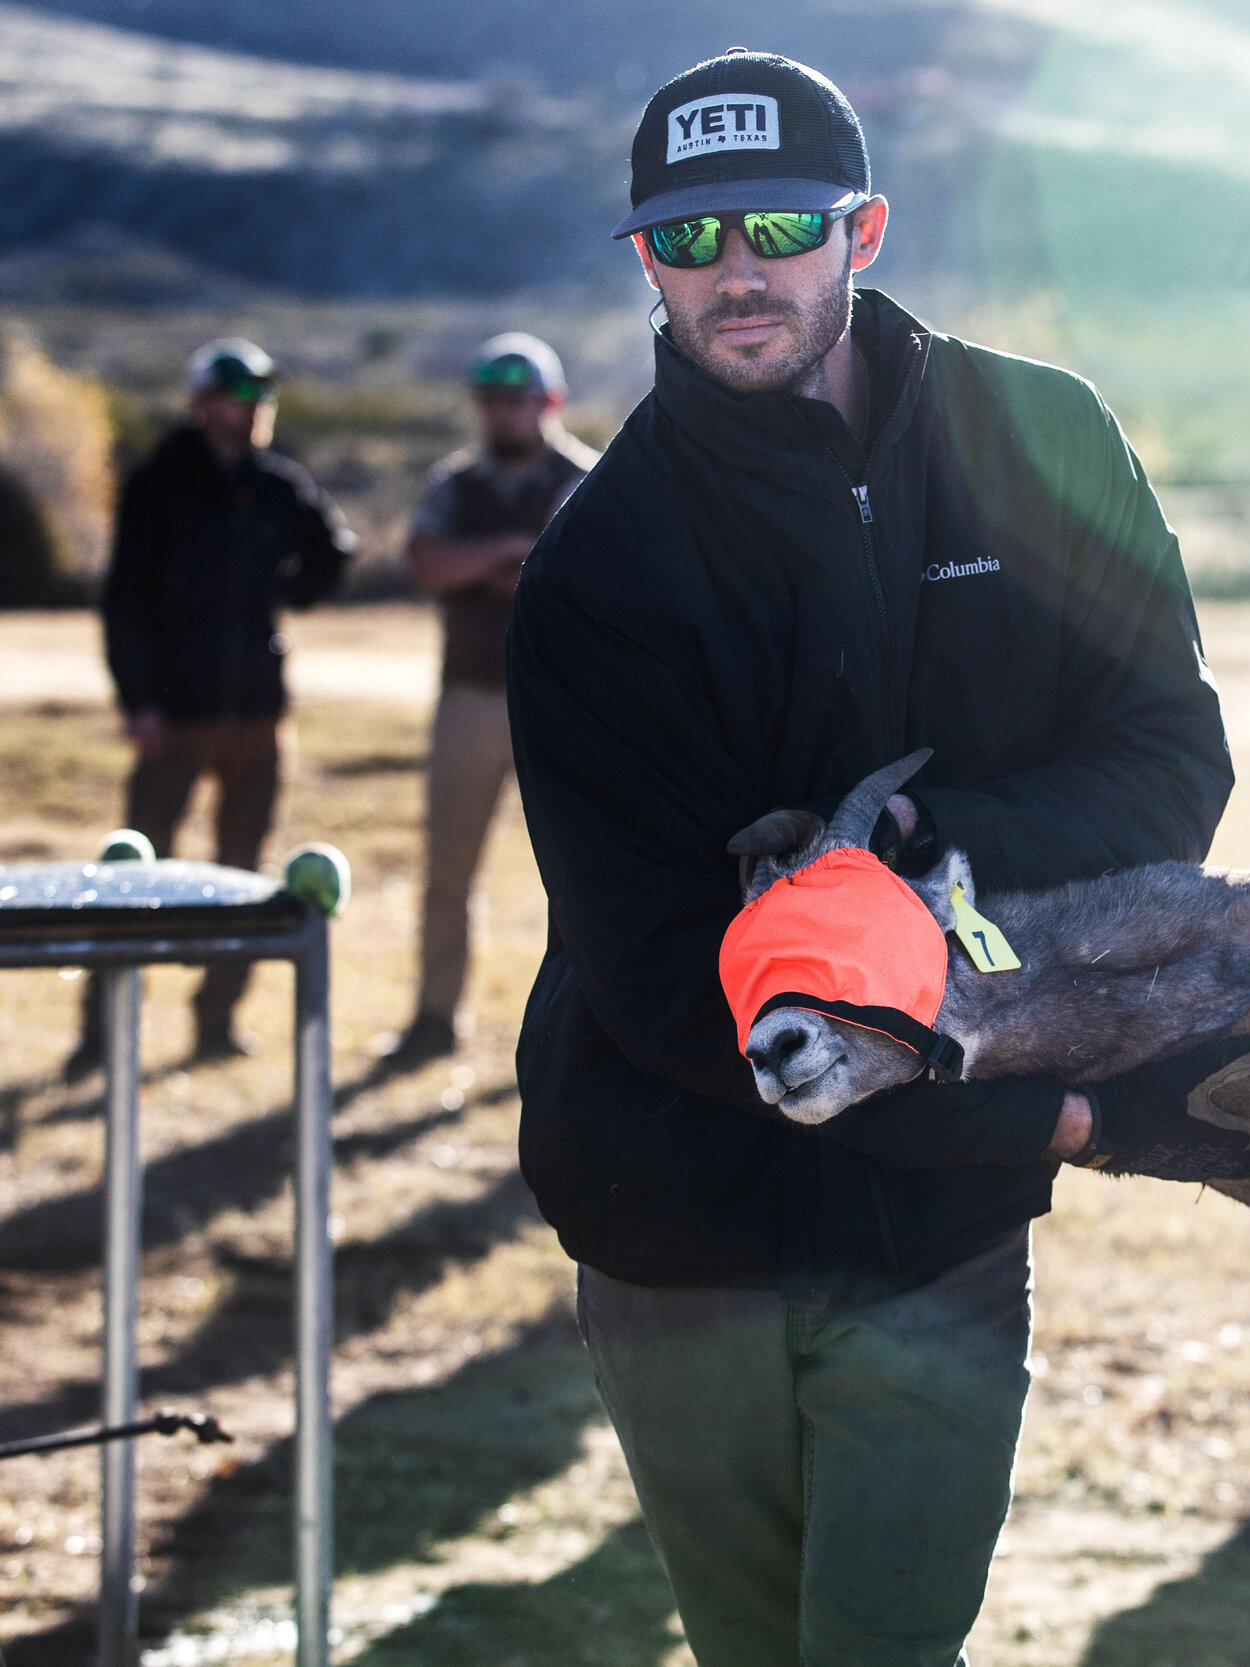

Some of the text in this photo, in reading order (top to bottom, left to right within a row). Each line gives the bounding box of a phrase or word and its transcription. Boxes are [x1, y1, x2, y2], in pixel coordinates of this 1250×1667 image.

[675, 104, 767, 140] YETI
[676, 134, 768, 153] AUSTIN TEXAS
[926, 555, 1001, 581] Columbia
[971, 930, 996, 967] 7
